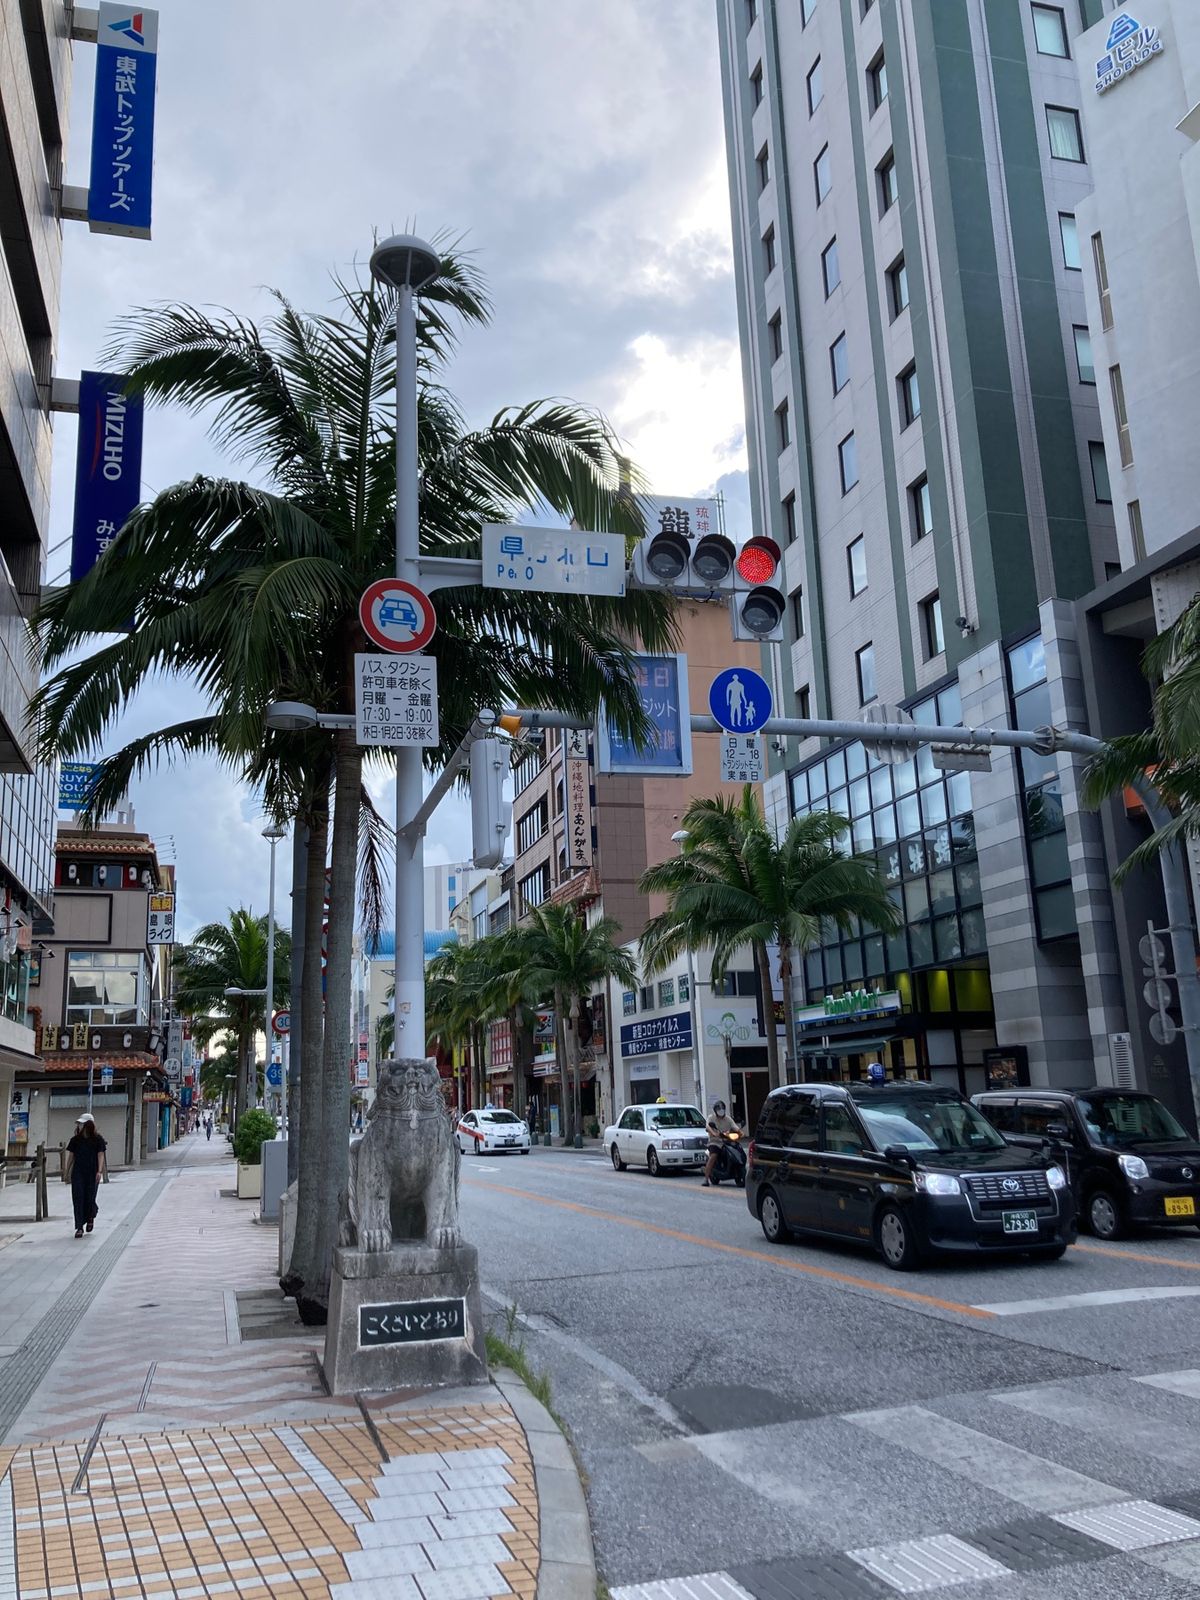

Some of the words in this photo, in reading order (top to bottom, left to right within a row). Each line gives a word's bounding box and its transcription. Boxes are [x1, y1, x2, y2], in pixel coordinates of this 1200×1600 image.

[1095, 69, 1121, 92] SHO
[1125, 41, 1161, 72] BLDG
[109, 55, 137, 212] 東武トップツアーズ
[103, 392, 127, 481] MIZUHO
[696, 507, 709, 540] 琉球
[96, 519, 115, 562] みず
[361, 660, 431, 675] バス・タクシー
[362, 675, 432, 691] 許可車を除く
[362, 691, 387, 705] 月曜
[408, 692, 432, 707] 金曜
[363, 707, 390, 721] 17:30
[405, 708, 432, 722] 19:00
[726, 749, 735, 759] 12
[750, 749, 760, 760] 18
[149, 927, 173, 940] ライブ
[632, 1017, 679, 1039] 新型コロナウイルス
[1011, 1219, 1036, 1231] 79-90
[366, 1310, 459, 1336] こくさいとおり
